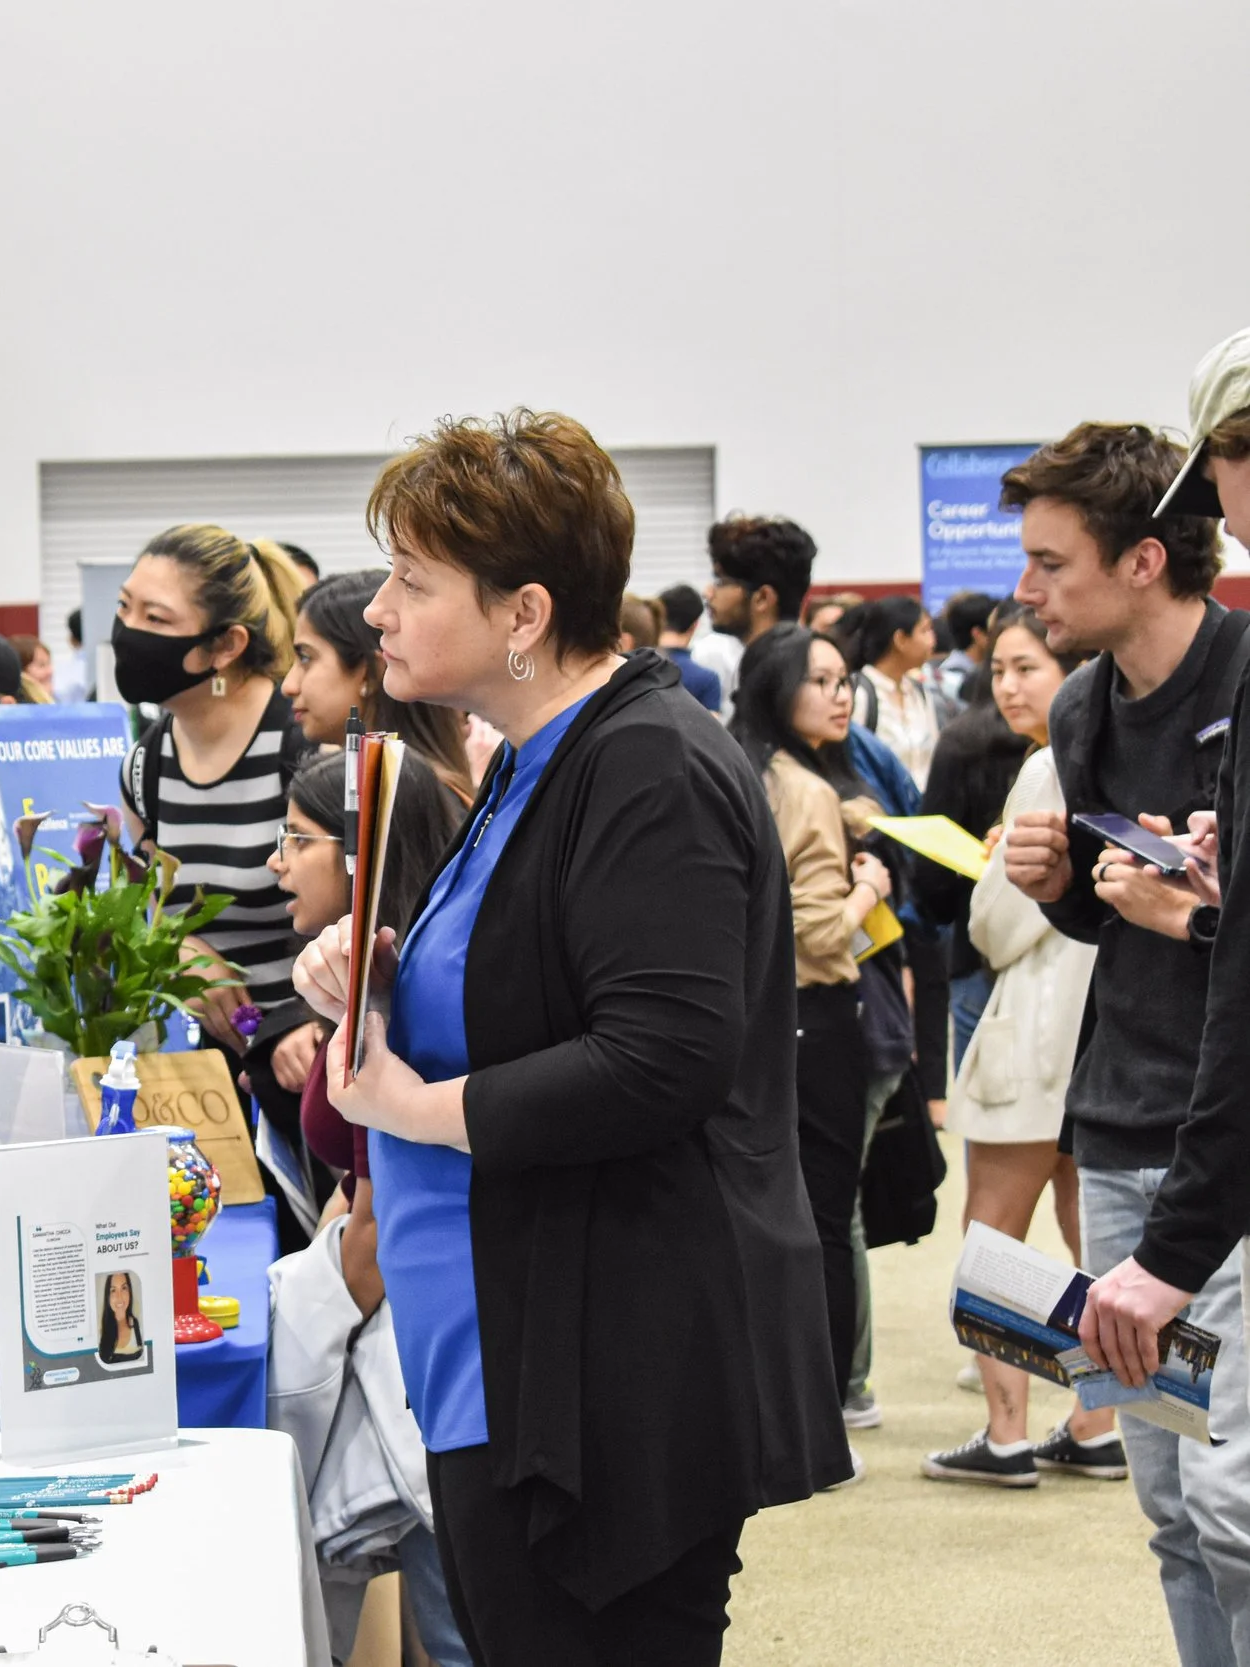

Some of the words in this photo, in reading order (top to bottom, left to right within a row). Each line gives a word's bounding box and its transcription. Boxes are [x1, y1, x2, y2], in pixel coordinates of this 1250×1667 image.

[927, 500, 990, 520] Career
[24, 740, 56, 761] CORE
[56, 738, 101, 760] VALUES
[102, 737, 126, 757] ARE
[95, 1231, 128, 1241] Employees
[129, 1229, 141, 1238] Say
[96, 1243, 123, 1254] ABOUT
[124, 1240, 139, 1251] US?
